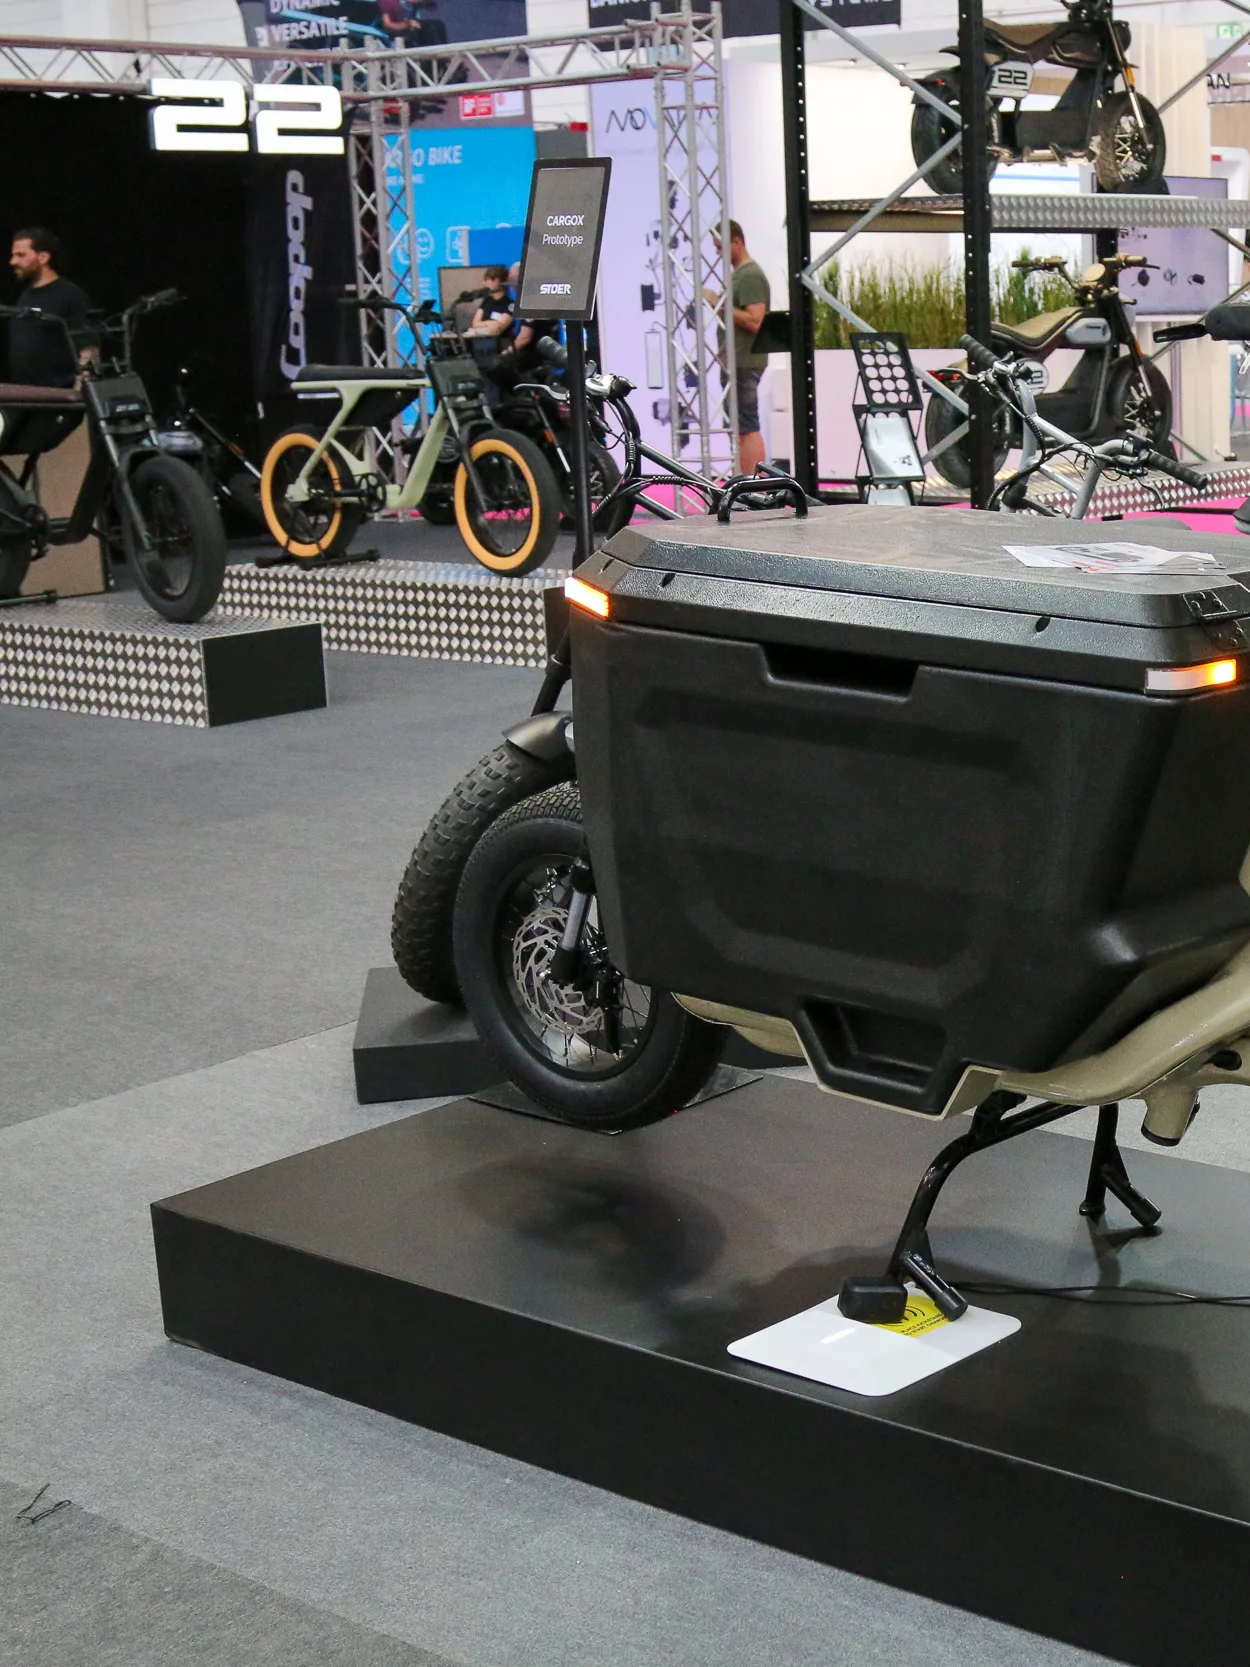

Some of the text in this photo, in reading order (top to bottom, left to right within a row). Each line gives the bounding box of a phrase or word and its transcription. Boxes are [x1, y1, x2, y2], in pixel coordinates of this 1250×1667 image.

[269, 16, 350, 42] VERSATILE
[997, 68, 1028, 86] 22
[151, 77, 345, 155] 22
[428, 145, 463, 166] BIKE
[546, 215, 585, 227] CARGOX
[542, 233, 584, 247] Prototype
[539, 283, 572, 295] STOER
